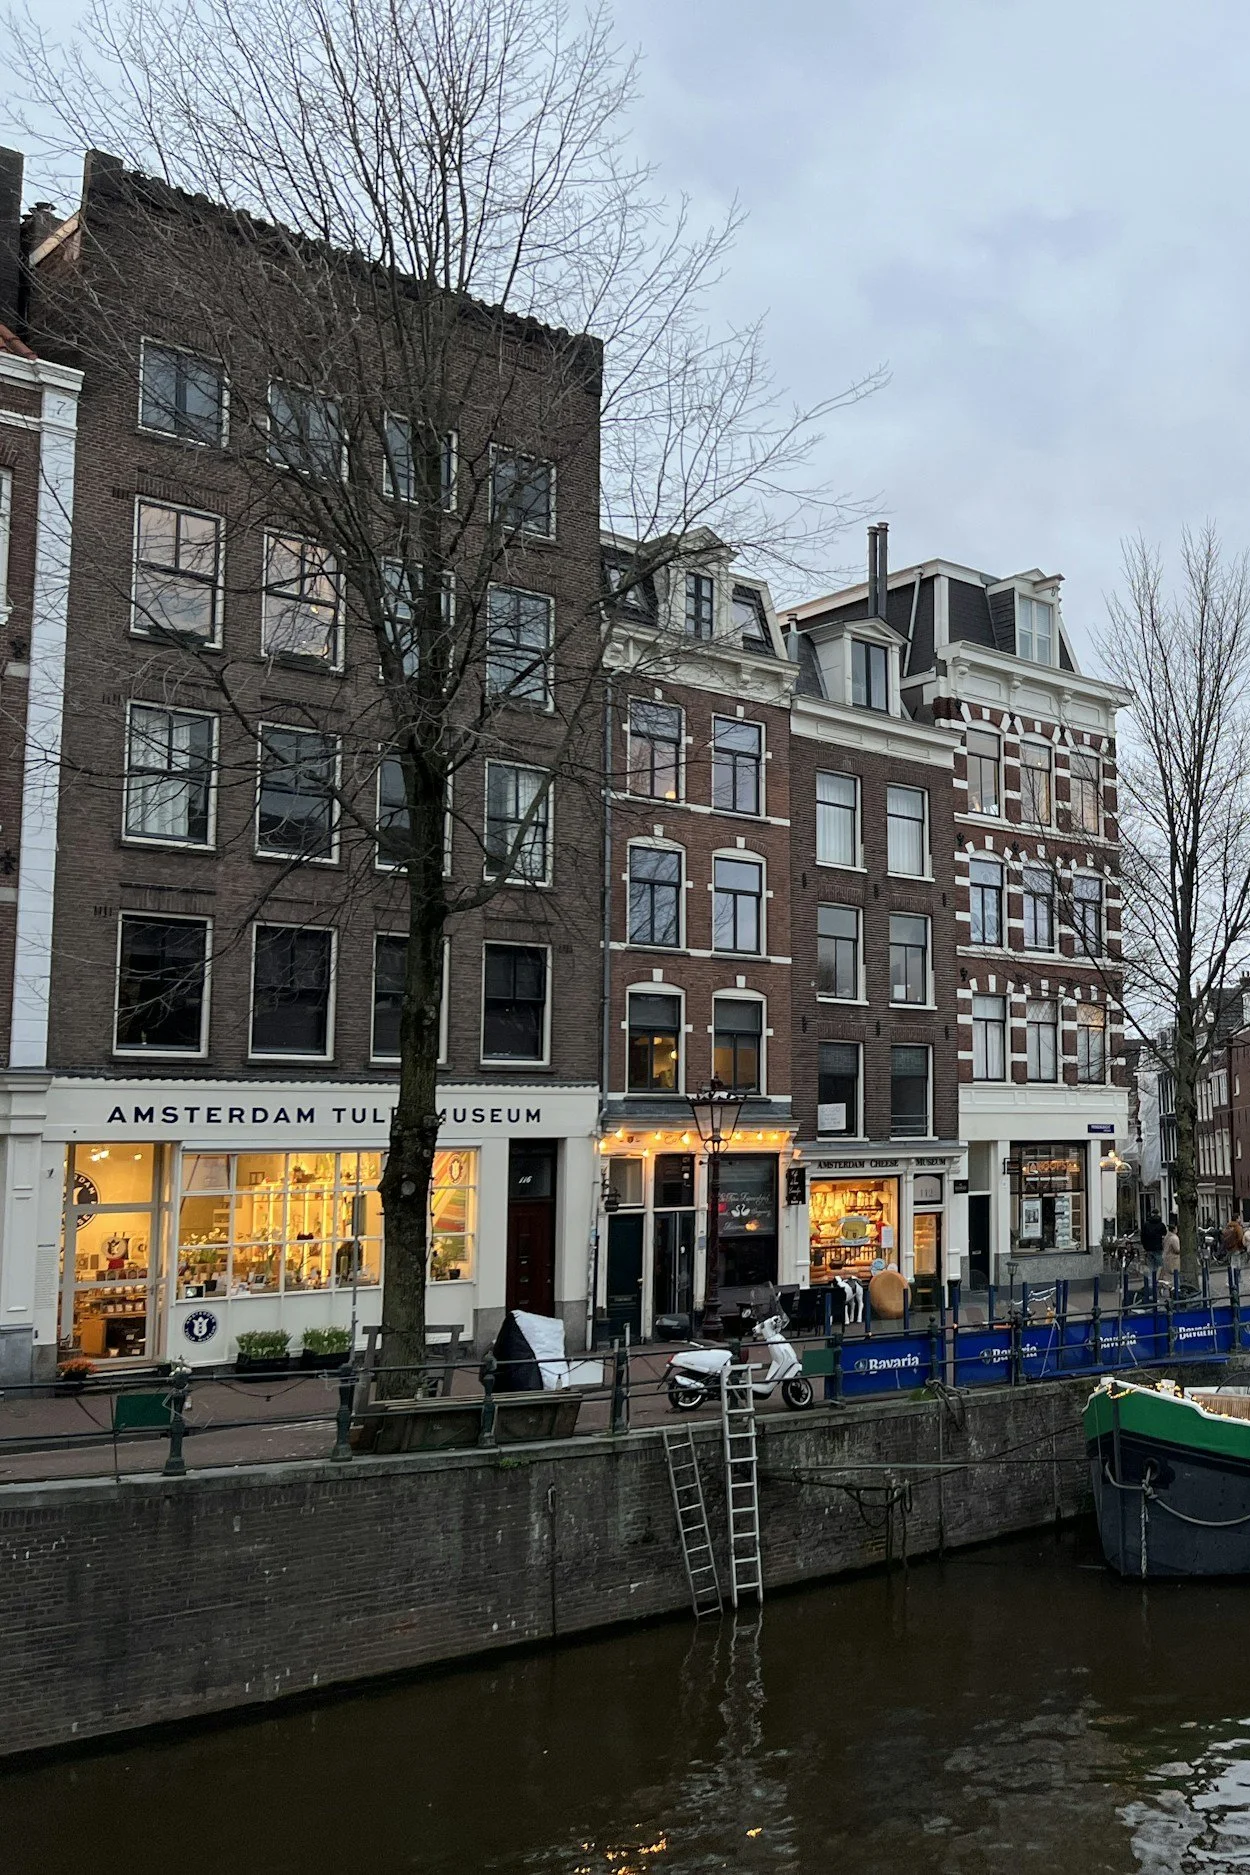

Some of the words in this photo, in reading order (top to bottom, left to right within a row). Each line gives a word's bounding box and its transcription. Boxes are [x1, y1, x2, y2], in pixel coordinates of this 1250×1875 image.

[106, 1106, 315, 1124] AMSTERDAM
[816, 1160, 866, 1169] AMSTERDAM
[870, 1159, 899, 1168] CHEESE
[519, 1176, 532, 1184] 116
[869, 1353, 920, 1374] Bavaria
